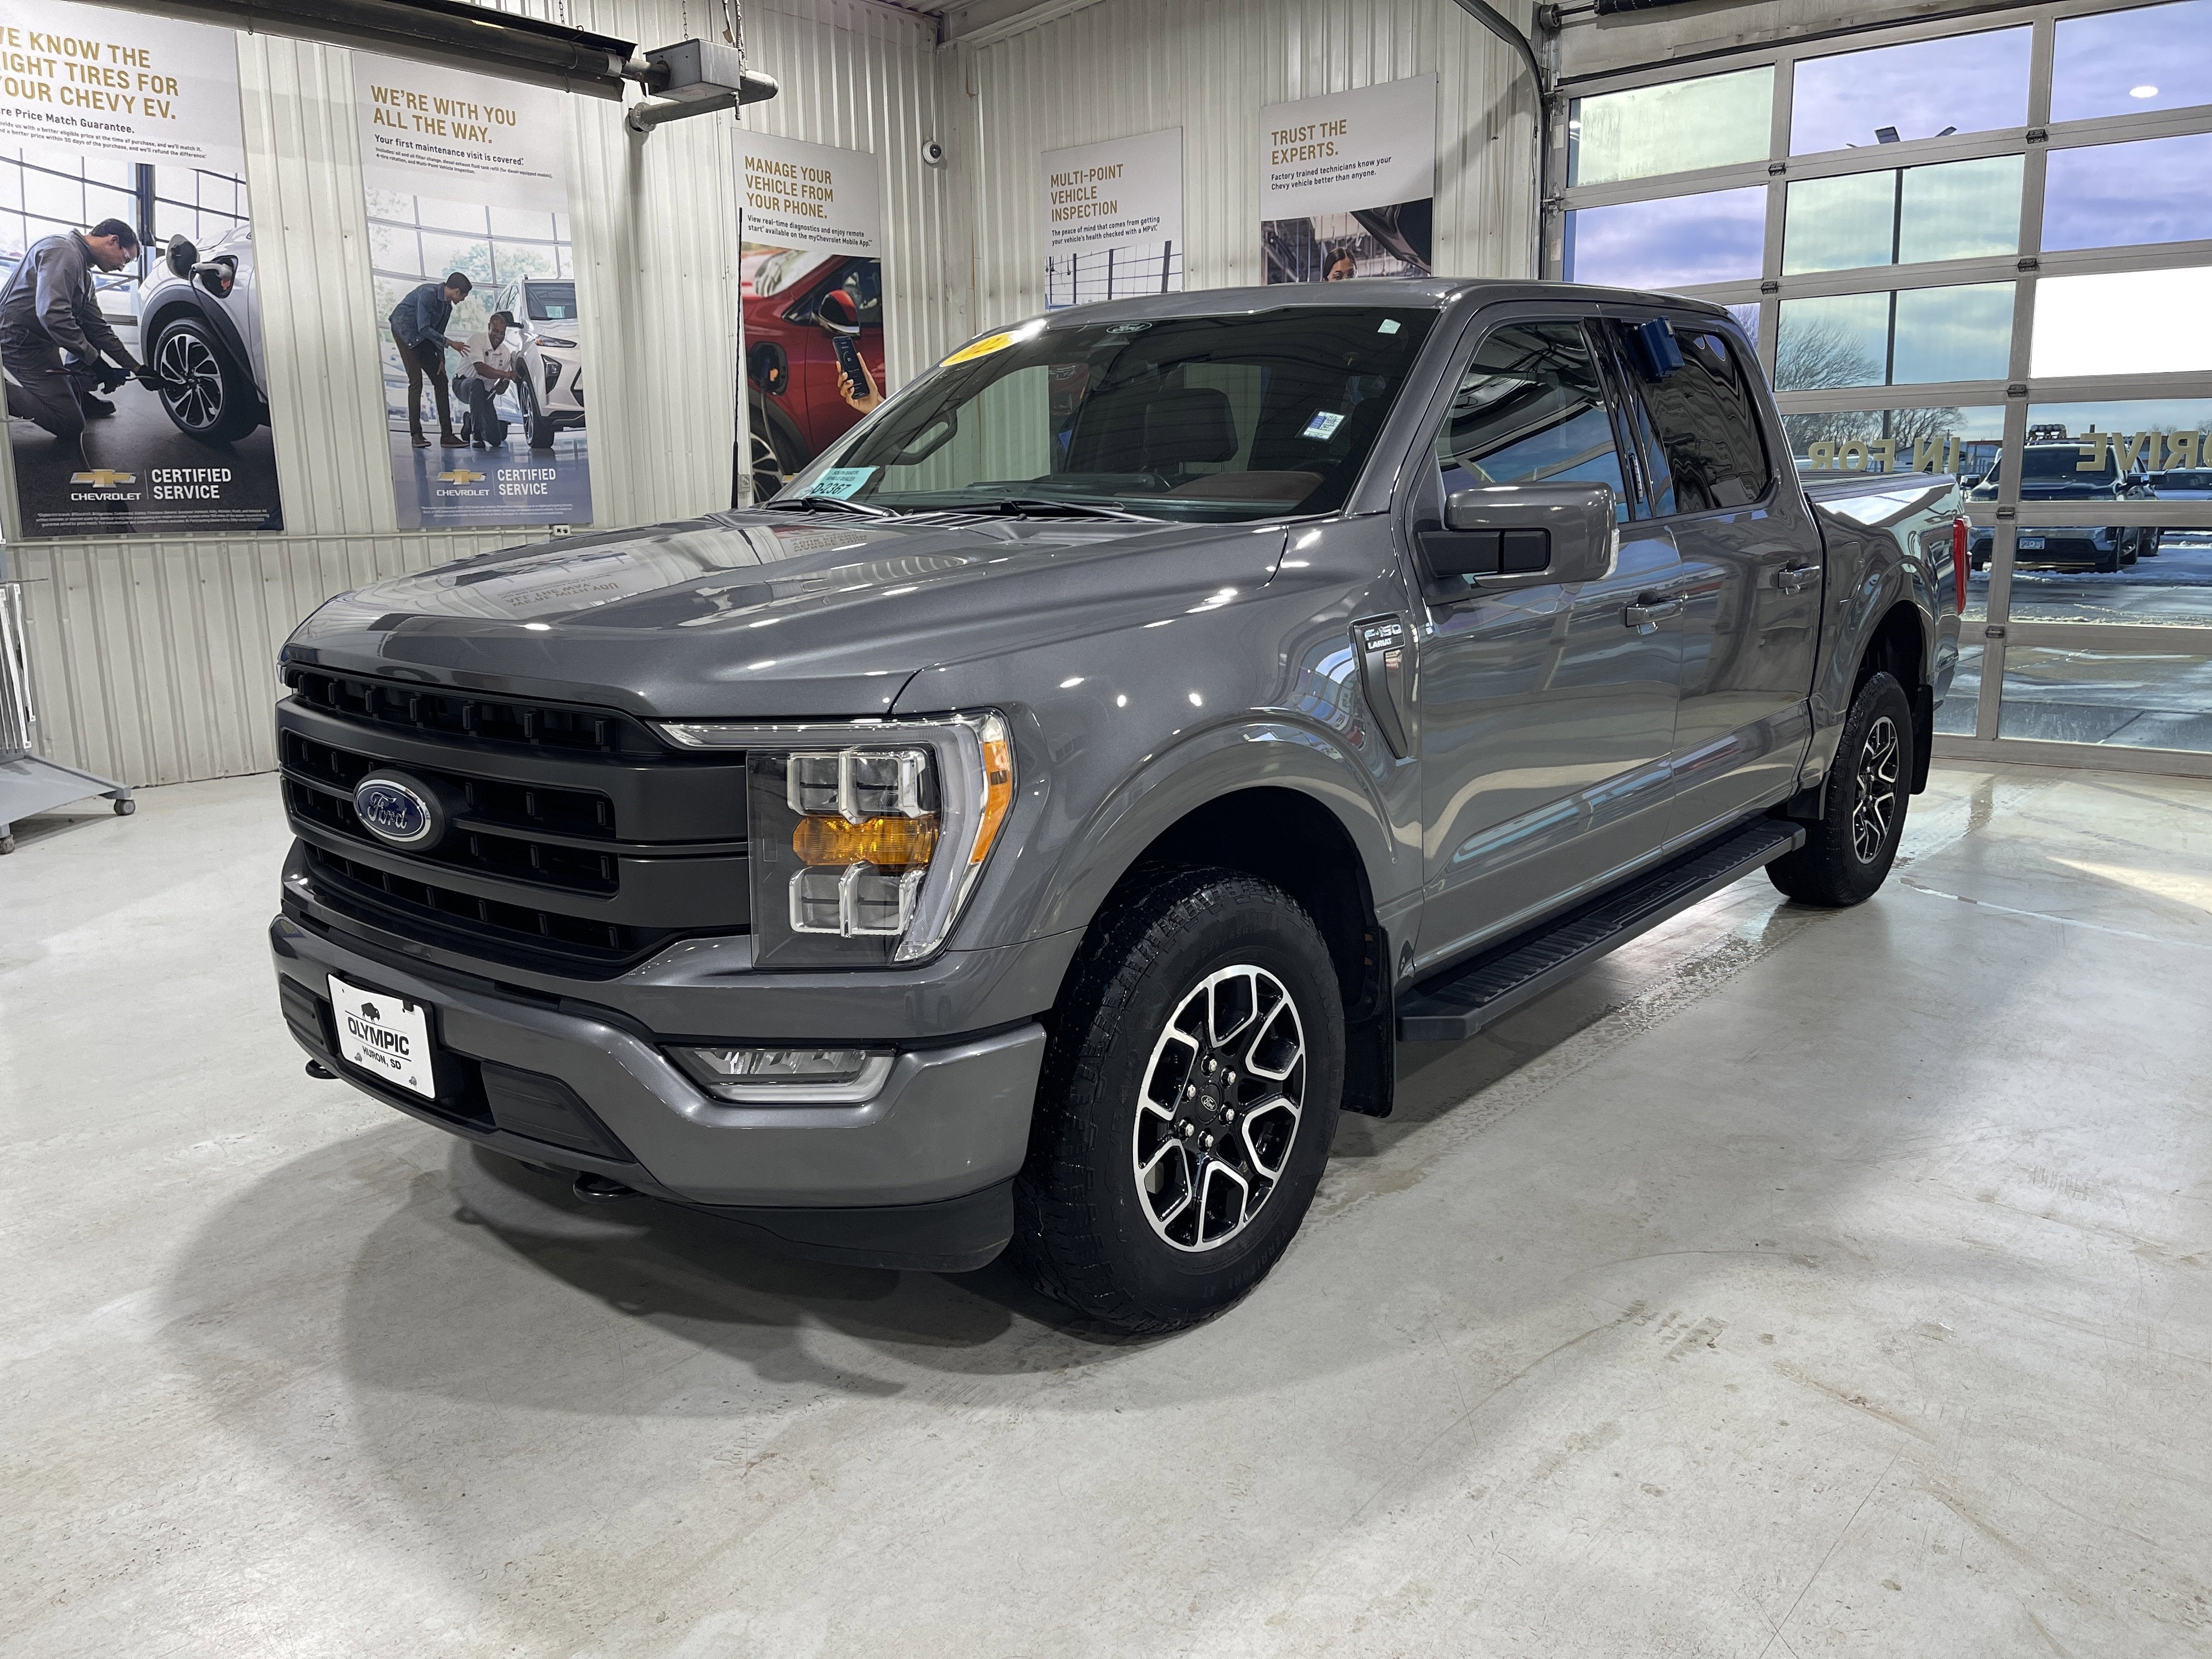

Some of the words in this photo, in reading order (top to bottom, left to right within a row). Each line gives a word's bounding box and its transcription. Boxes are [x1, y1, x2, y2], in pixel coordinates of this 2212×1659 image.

[30, 31, 100, 60] KNOW
[107, 44, 151, 69] THE
[0, 51, 57, 78] IGHT
[64, 62, 130, 89] TIRES
[137, 72, 179, 96] FOR
[0, 76, 53, 103] OUR
[60, 86, 136, 114] CHEVY
[144, 98, 177, 120] EV.
[370, 84, 428, 111] WE'RE
[433, 97, 478, 120] WITH
[483, 105, 516, 126] YOU
[0, 108, 12, 116] re
[15, 108, 42, 121] Price
[46, 113, 77, 126] Match
[81, 119, 135, 133] Guarantee.
[374, 108, 408, 130] ALL
[412, 115, 447, 136] THE
[452, 122, 493, 144] WAY.
[1271, 125, 1316, 146] TRUST
[1320, 119, 1347, 138] THE
[375, 134, 393, 145] Your
[396, 138, 413, 149] first
[415, 144, 465, 157] maintenance
[467, 151, 483, 160] visit
[484, 153, 491, 161] is
[1272, 142, 1339, 165] EXPERTS.
[744, 156, 797, 179] MANAGE
[800, 166, 832, 185] YOUR
[1051, 163, 1123, 188] MULTI-POINT
[1271, 172, 1294, 181] Factory
[1296, 168, 1318, 177] trained
[1320, 163, 1356, 174] technicians
[1357, 160, 1375, 168] know
[1376, 156, 1391, 166] your
[1291, 179, 1312, 188] vehicle
[1314, 176, 1334, 185] better
[1336, 173, 1350, 182] than
[1351, 170, 1376, 179] anyone.
[745, 174, 797, 196] VEHICLE
[802, 184, 833, 202] FROM
[1051, 185, 1097, 205] VEHICLE
[746, 192, 780, 212] YOUR
[784, 199, 827, 219] PHONE.
[1052, 200, 1118, 222] INSPECTION
[748, 215, 761, 223] View
[763, 218, 788, 228] real-time
[789, 222, 820, 232] diagnostics
[1141, 216, 1160, 225] getting
[765, 228, 789, 237] available
[809, 234, 841, 244] myChevrolet
[1064, 235, 1085, 244] vehicle's
[1103, 229, 1124, 239] checked
[151, 468, 232, 483] CERTIFIED
[497, 469, 556, 481] CERTIFIED
[71, 493, 142, 501] CHEVROLET
[153, 485, 220, 500] SERVICE
[499, 483, 548, 495] SERVICE
[812, 483, 851, 494] D-2367
[1368, 638, 1392, 650] LARIAT
[367, 792, 407, 829] Ford
[348, 1017, 409, 1056] OLYMPIC
[362, 1046, 389, 1068] HURON,
[391, 1059, 402, 1070] SD
[1203, 1097, 1216, 1110] Ford
